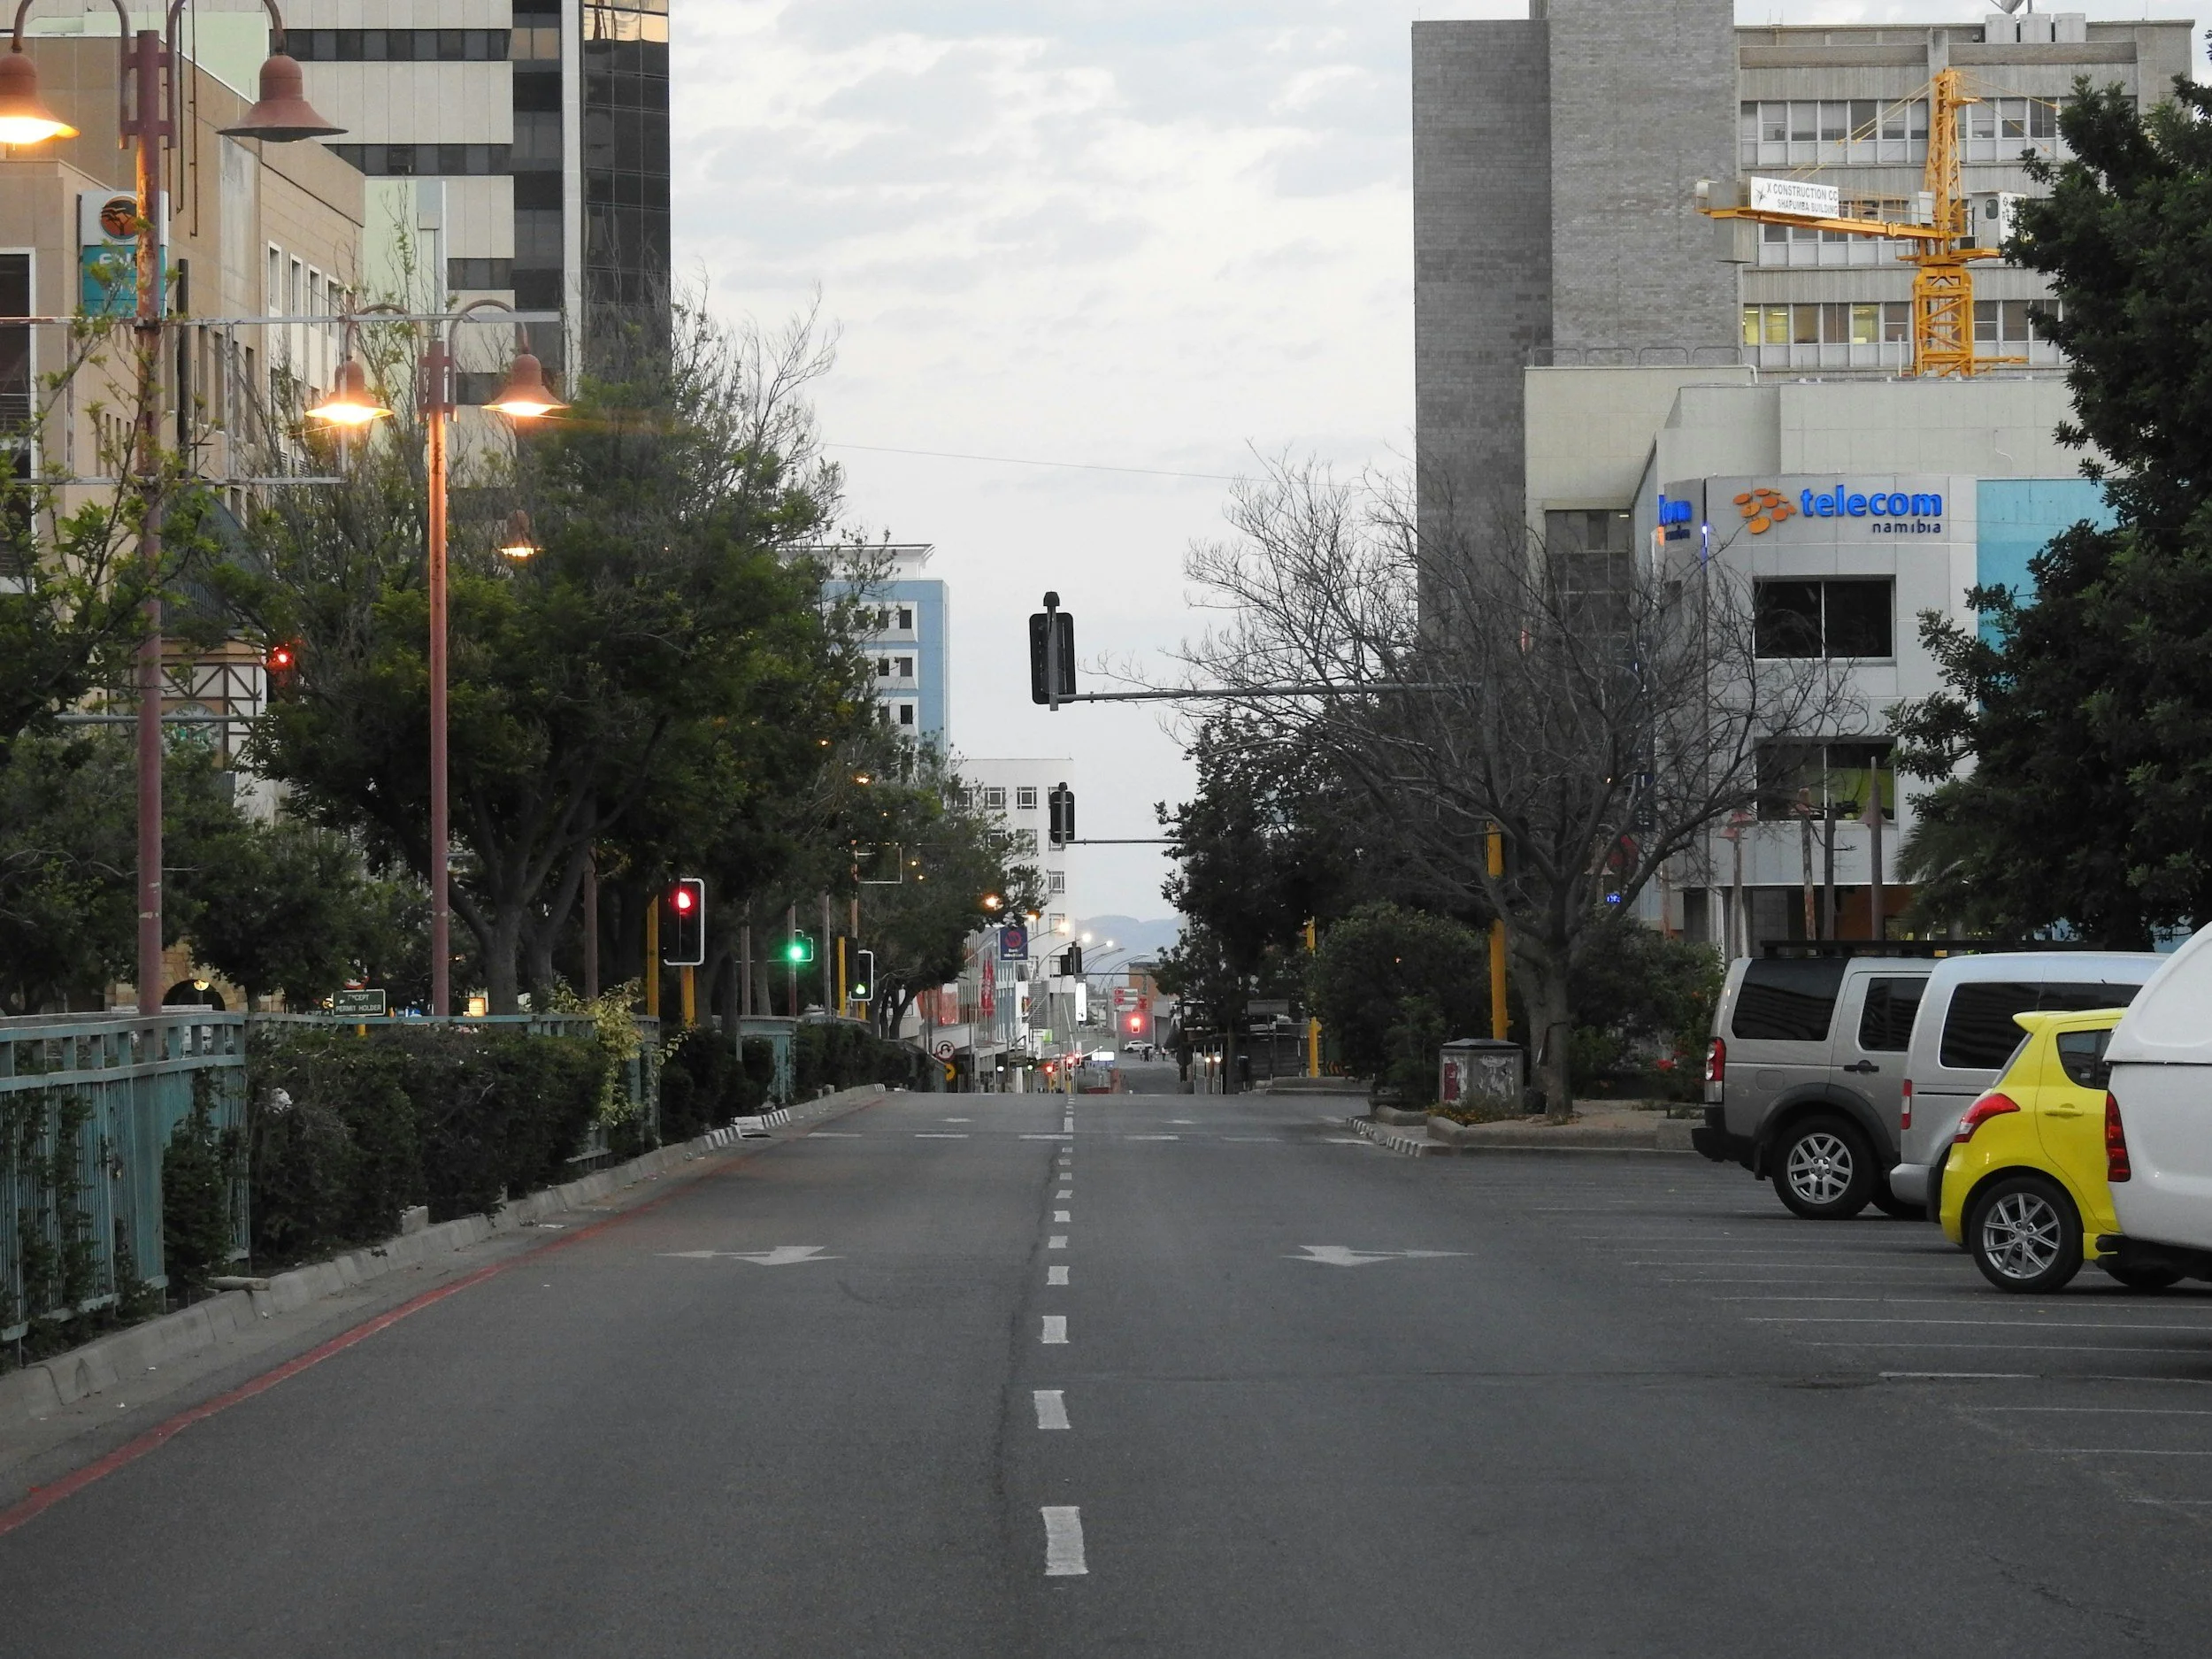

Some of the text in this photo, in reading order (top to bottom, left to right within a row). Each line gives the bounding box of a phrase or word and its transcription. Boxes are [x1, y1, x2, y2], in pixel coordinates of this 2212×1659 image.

[1773, 183, 1826, 200] CONSTRUCTION
[1829, 190, 1838, 202] CC
[1777, 198, 1838, 215] SHAPUMBA BUILDING
[1801, 484, 1942, 517] telecom
[1872, 518, 1941, 534] namibia
